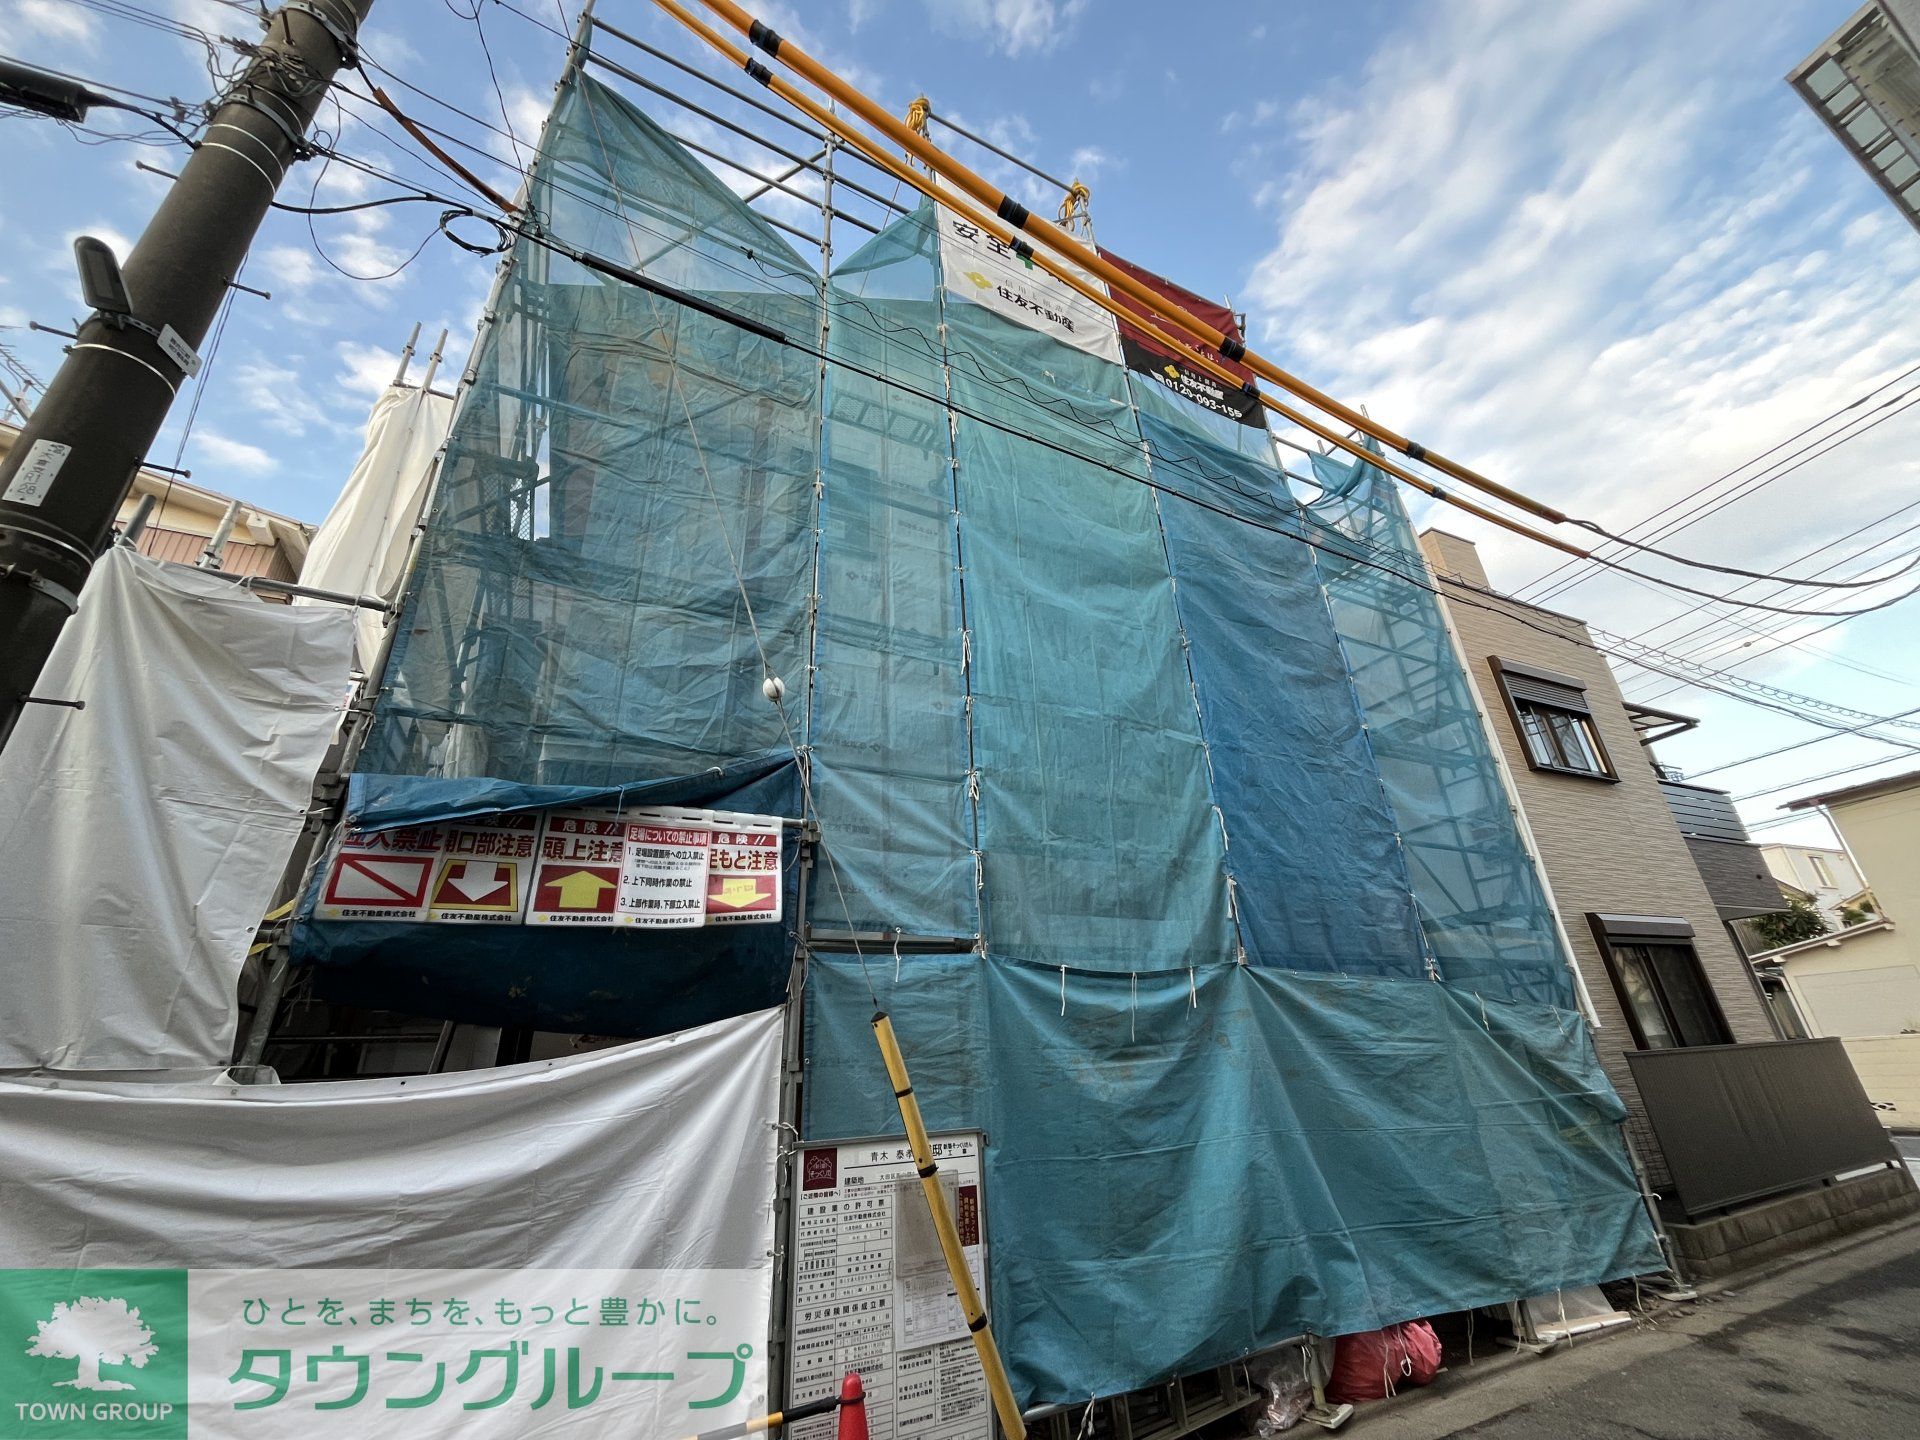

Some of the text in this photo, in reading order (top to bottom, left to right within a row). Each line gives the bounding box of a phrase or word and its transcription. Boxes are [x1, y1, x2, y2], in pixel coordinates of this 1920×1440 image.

[997, 285, 1076, 333] 住友不動産
[542, 836, 624, 862] 頭上注意
[342, 909, 416, 918] 住友不動産株式会社
[441, 912, 513, 922] 住友不動産株式会社
[635, 917, 695, 925] 住友不動産株式会社
